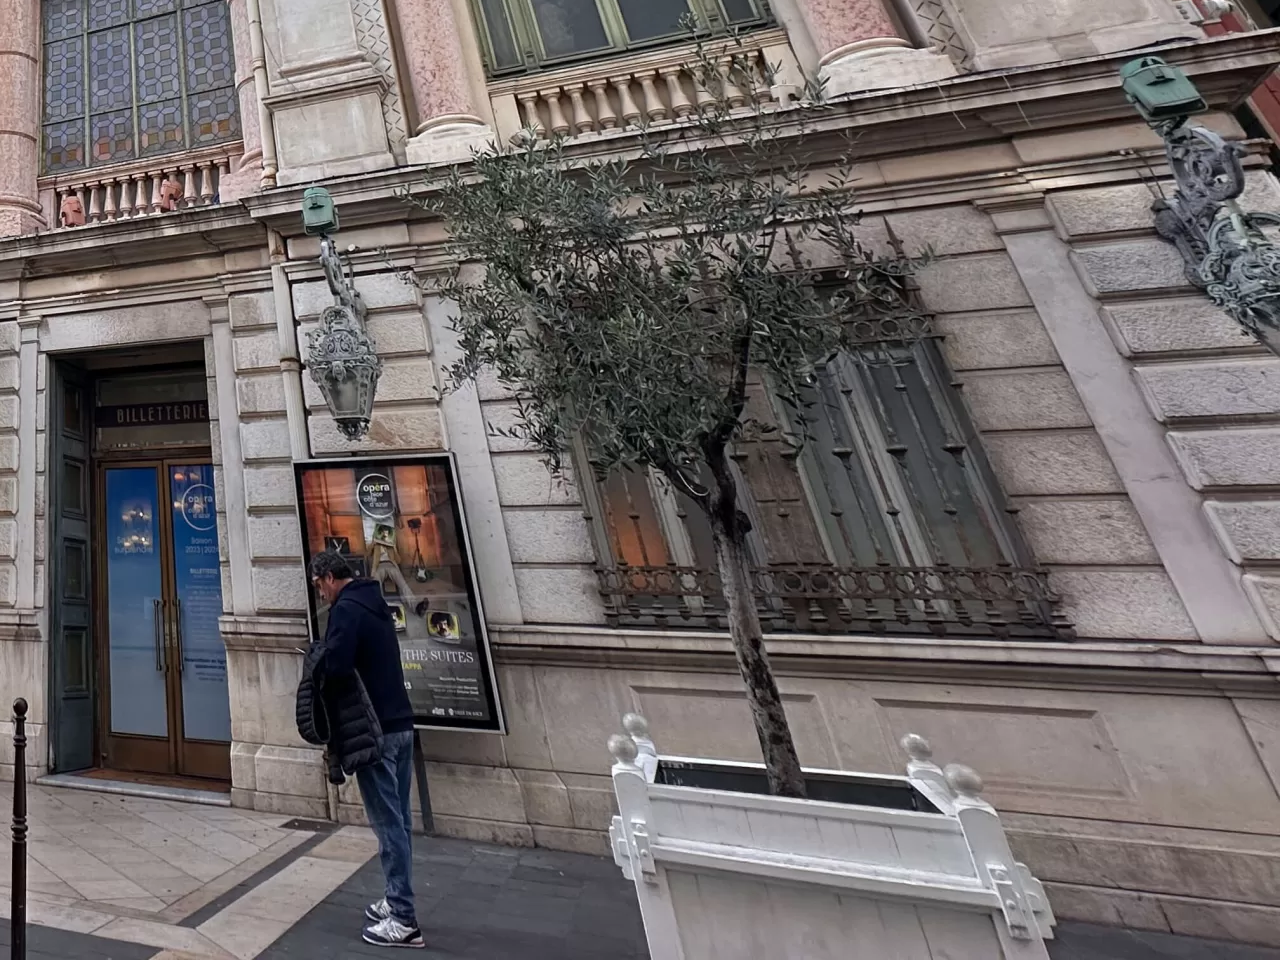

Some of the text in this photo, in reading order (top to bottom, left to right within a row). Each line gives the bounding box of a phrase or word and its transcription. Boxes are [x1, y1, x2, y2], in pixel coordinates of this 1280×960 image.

[117, 404, 206, 424] BILLETTERIE
[363, 482, 390, 494] opéra
[188, 495, 213, 505] opra
[403, 649, 474, 663] THE SUITES
